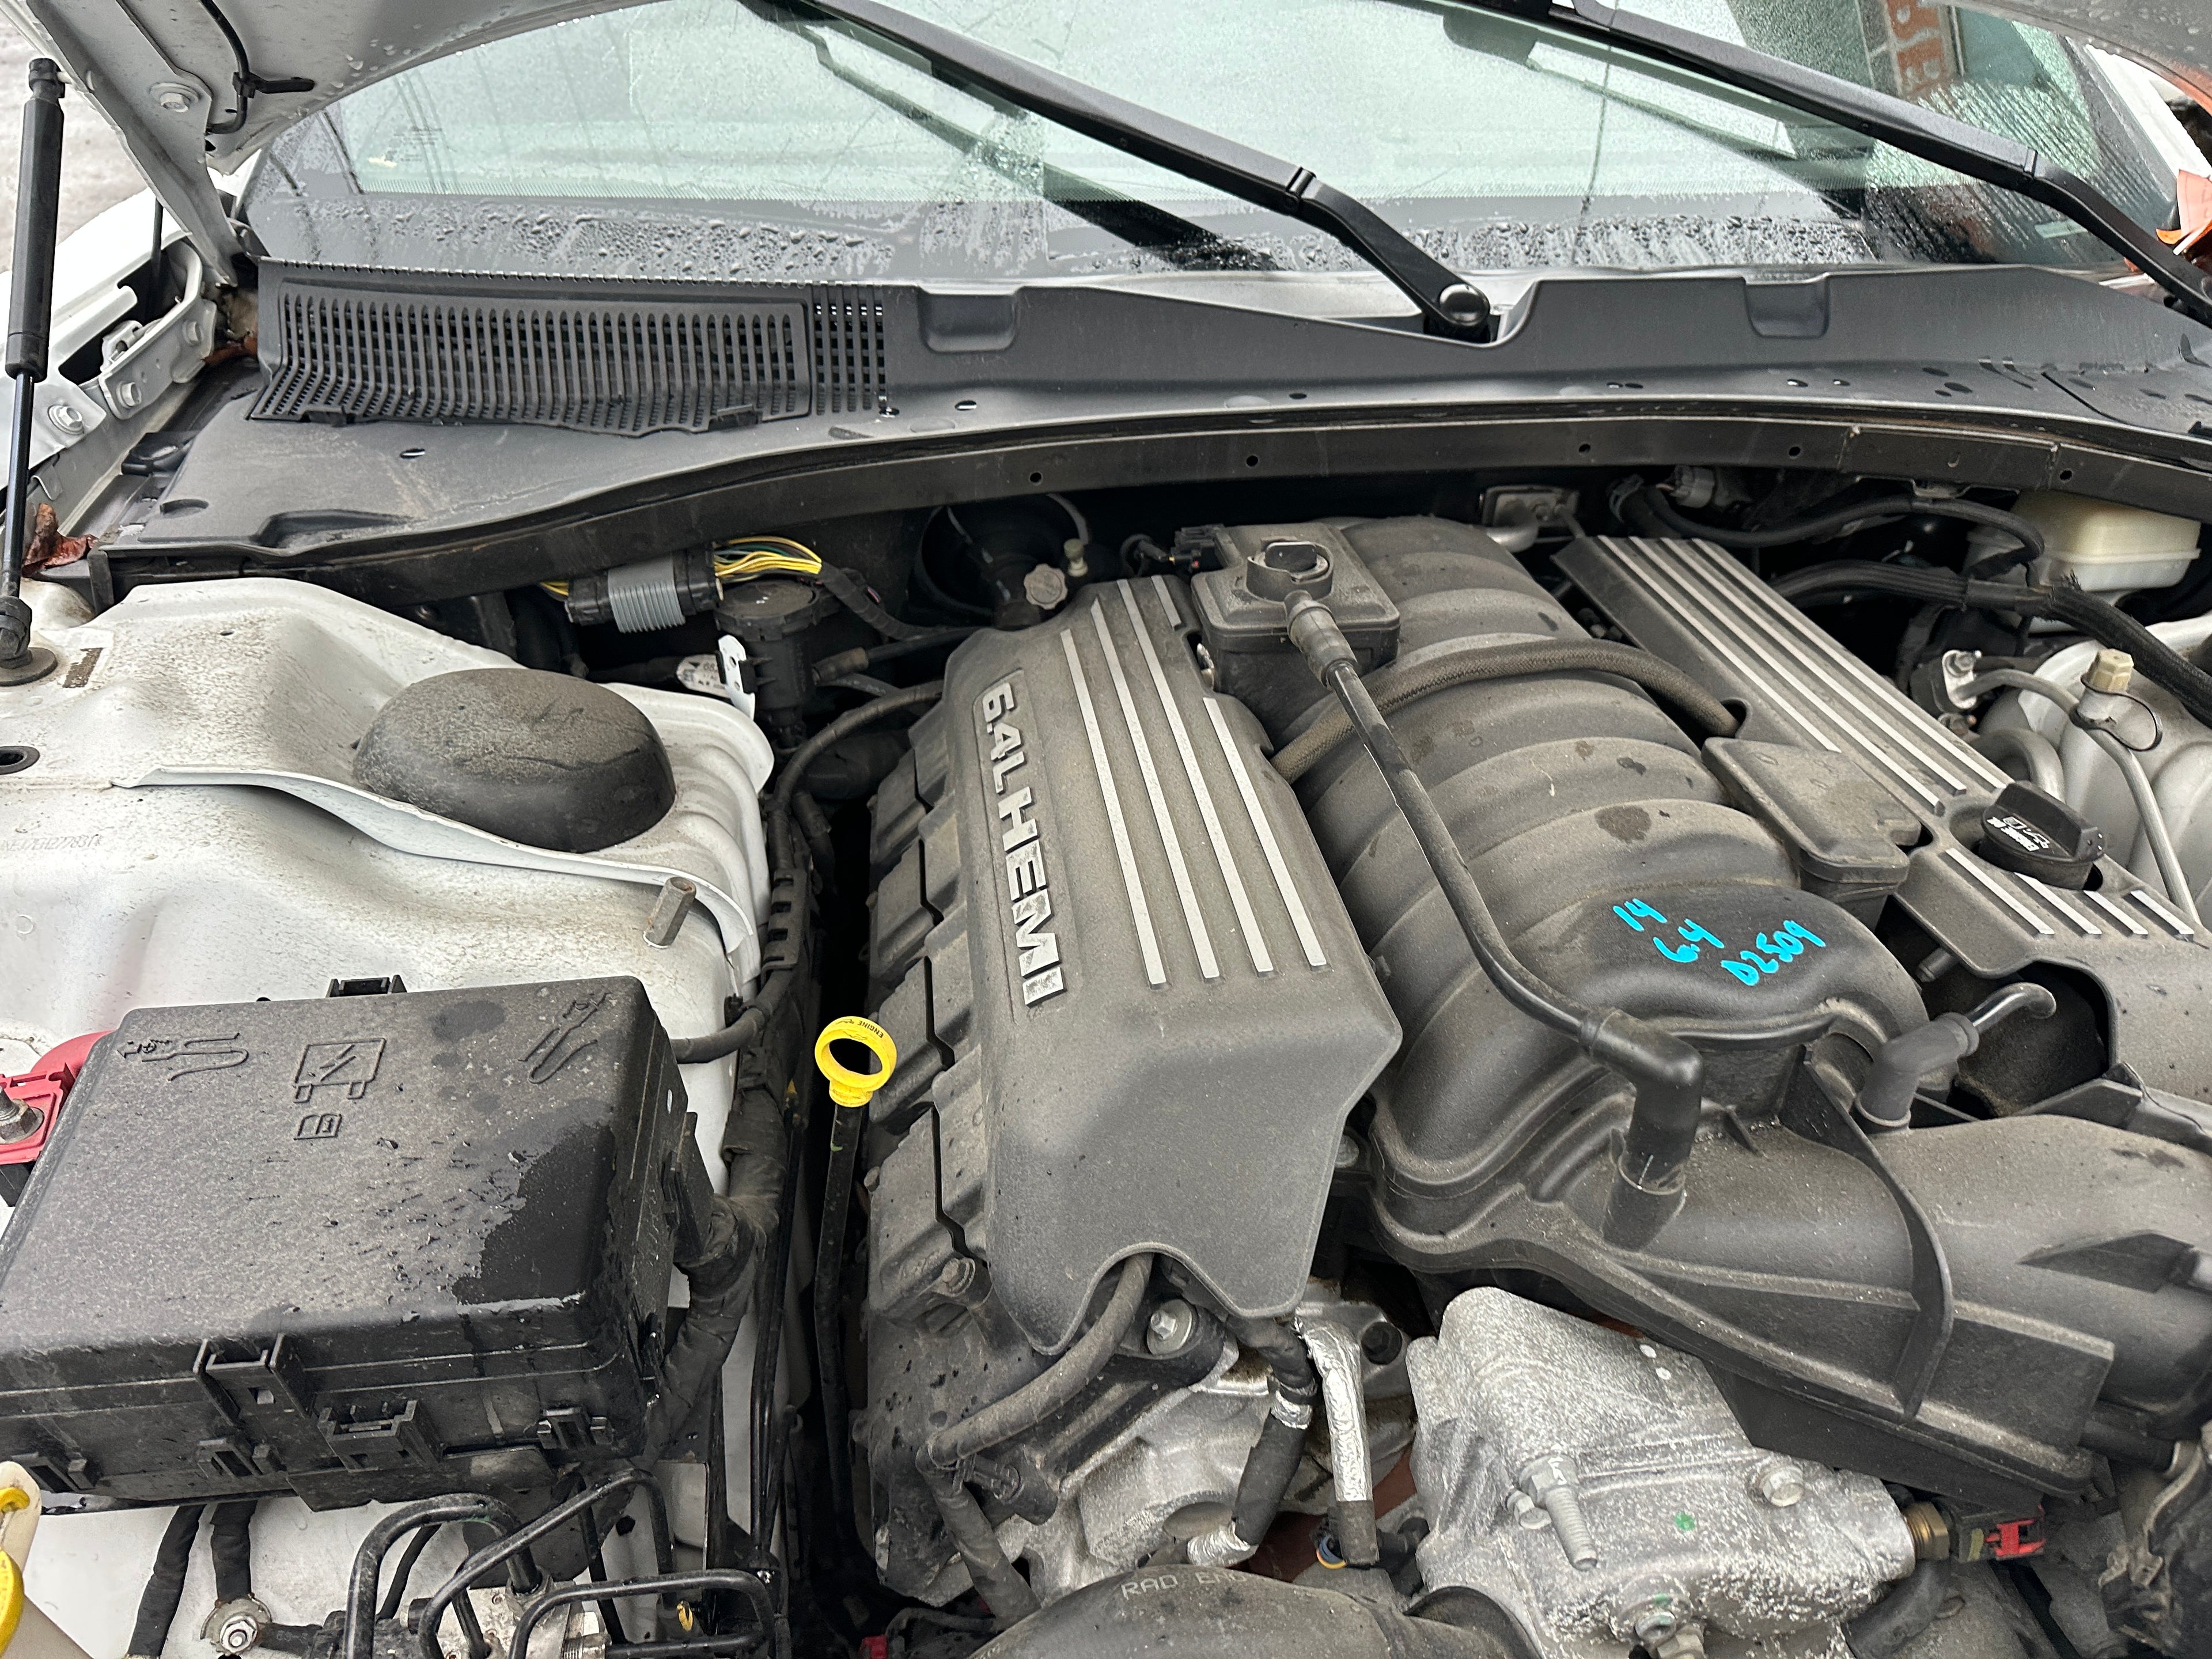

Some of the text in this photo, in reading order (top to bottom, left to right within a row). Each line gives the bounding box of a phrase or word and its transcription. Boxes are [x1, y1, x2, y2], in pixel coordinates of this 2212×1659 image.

[982, 682, 1065, 1006] 6.4L HEMI
[1612, 897, 1668, 932] 14
[1652, 918, 1725, 963] 6.4
[857, 1020, 884, 1039] ENGINE
[1120, 1574, 1179, 1601] RAD
